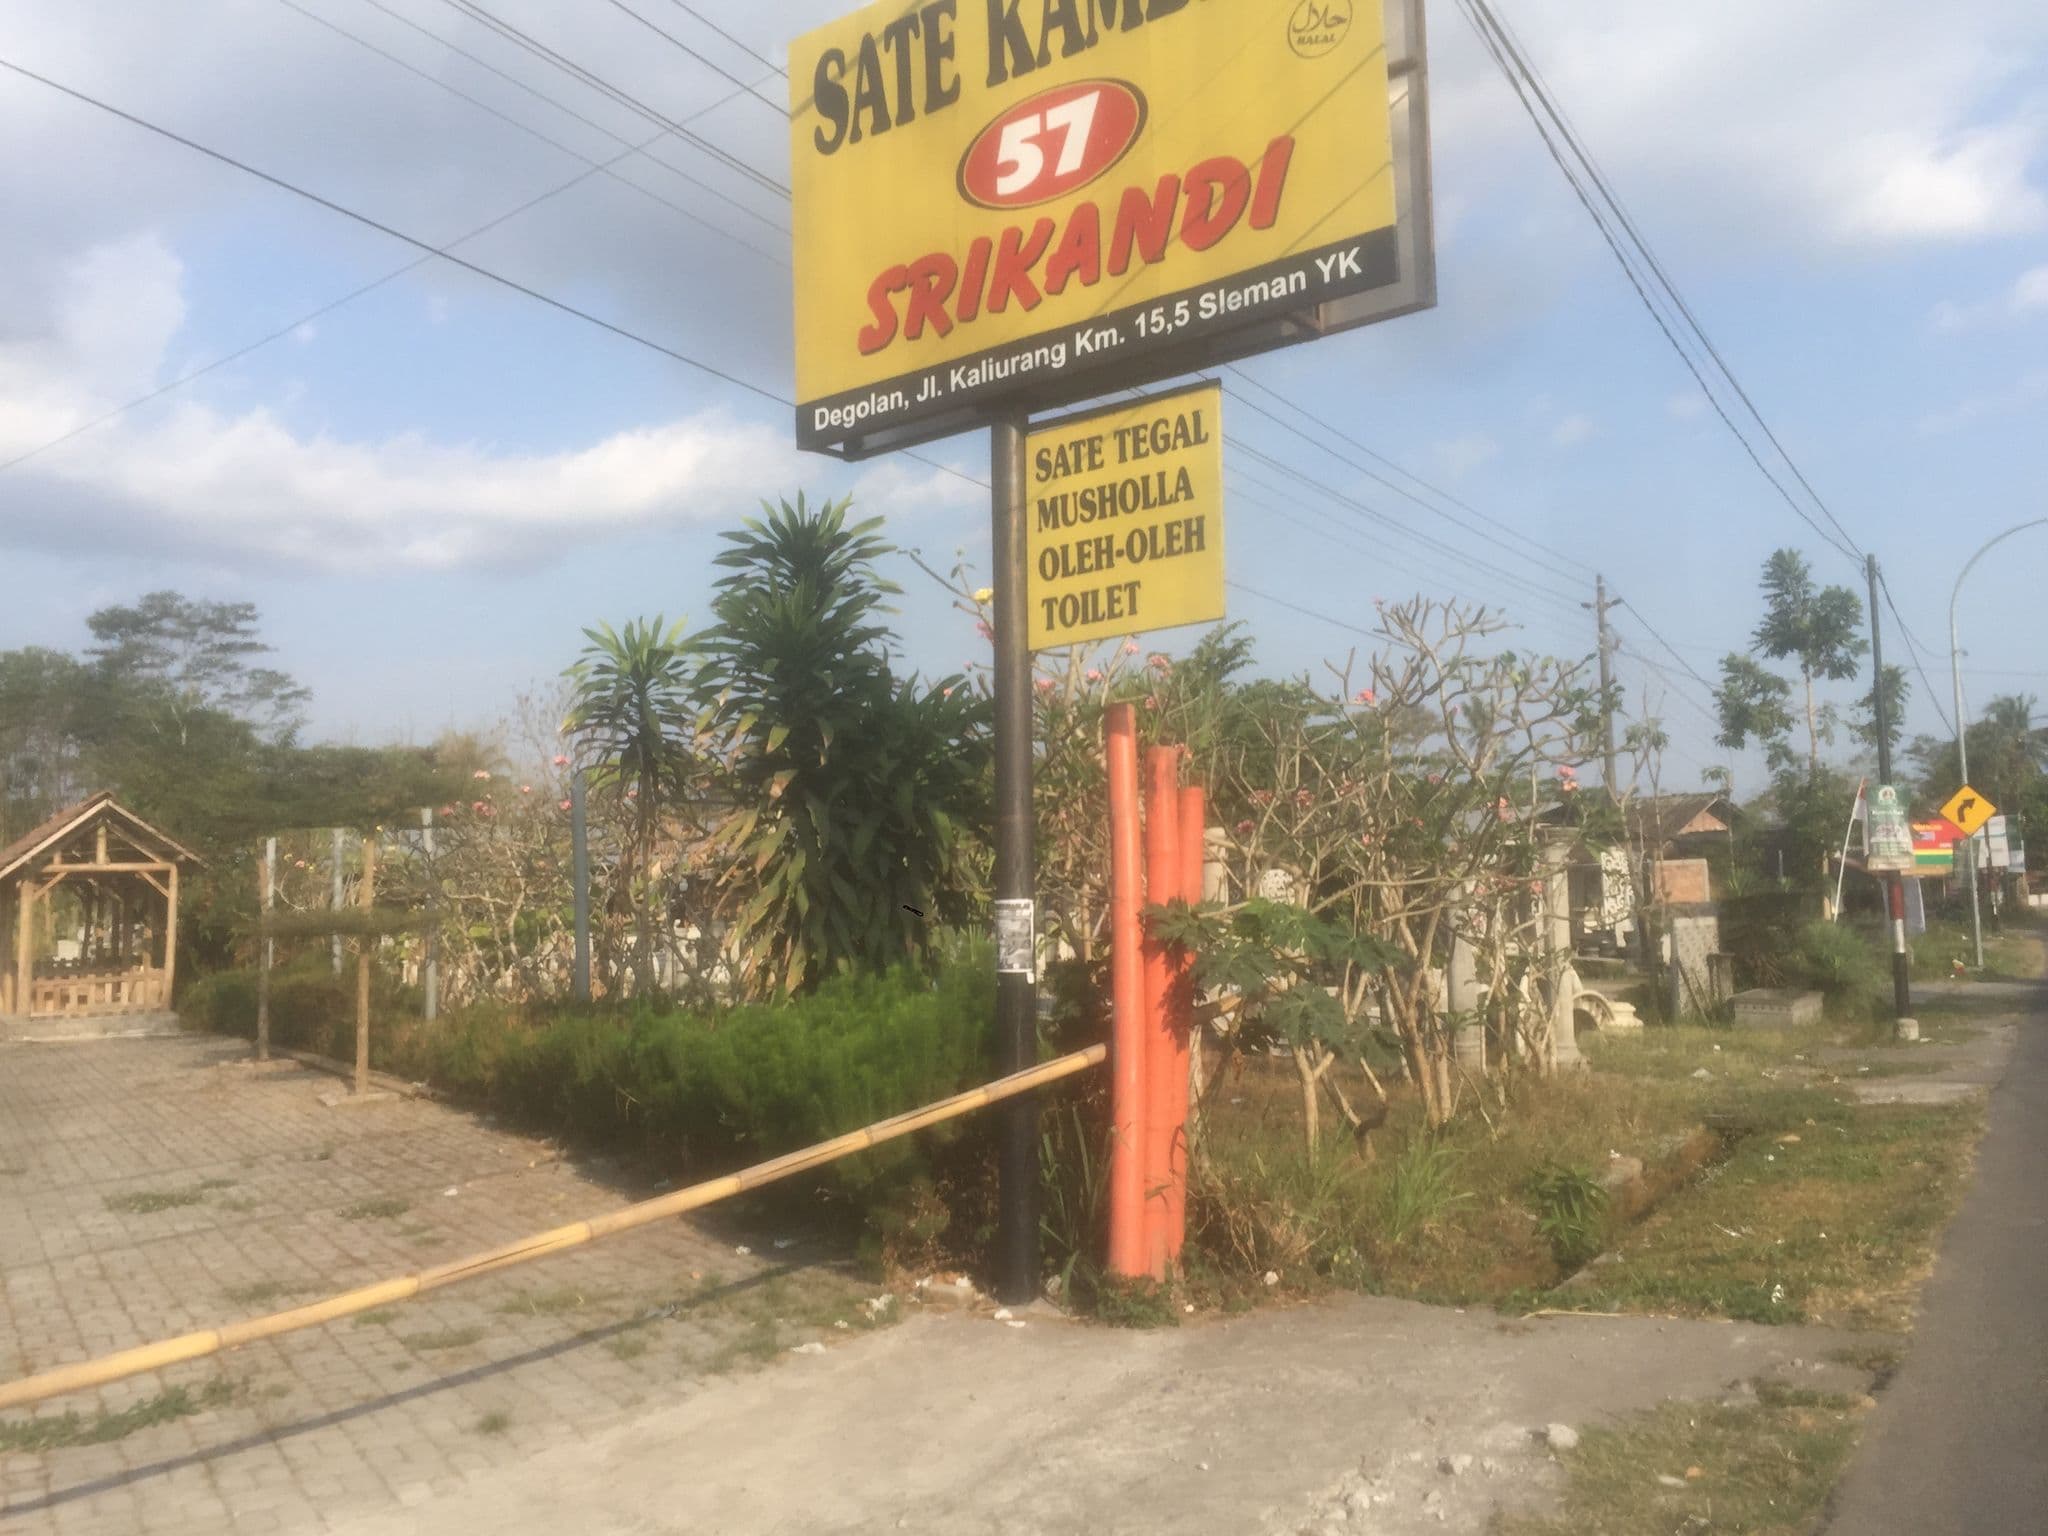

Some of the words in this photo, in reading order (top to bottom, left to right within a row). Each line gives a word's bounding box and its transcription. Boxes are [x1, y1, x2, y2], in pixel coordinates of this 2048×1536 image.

[813, 0, 961, 155] SATE
[996, 90, 1100, 196] 57
[857, 135, 1296, 356] SRIKANDI
[814, 390, 909, 431] Degolan,
[916, 376, 942, 402] Jl.
[950, 342, 1066, 393] Kaliurang
[1075, 328, 1125, 356] Km.
[1135, 300, 1190, 338] 15,5
[1198, 269, 1307, 320] Sleman
[1315, 247, 1362, 284] YK
[1035, 435, 1104, 482] SATE
[1114, 409, 1209, 464] TEGAL
[1037, 466, 1194, 532] MUSHOLLA
[1039, 515, 1206, 581] OLEH-OLEH
[1042, 580, 1141, 631] TOILET
